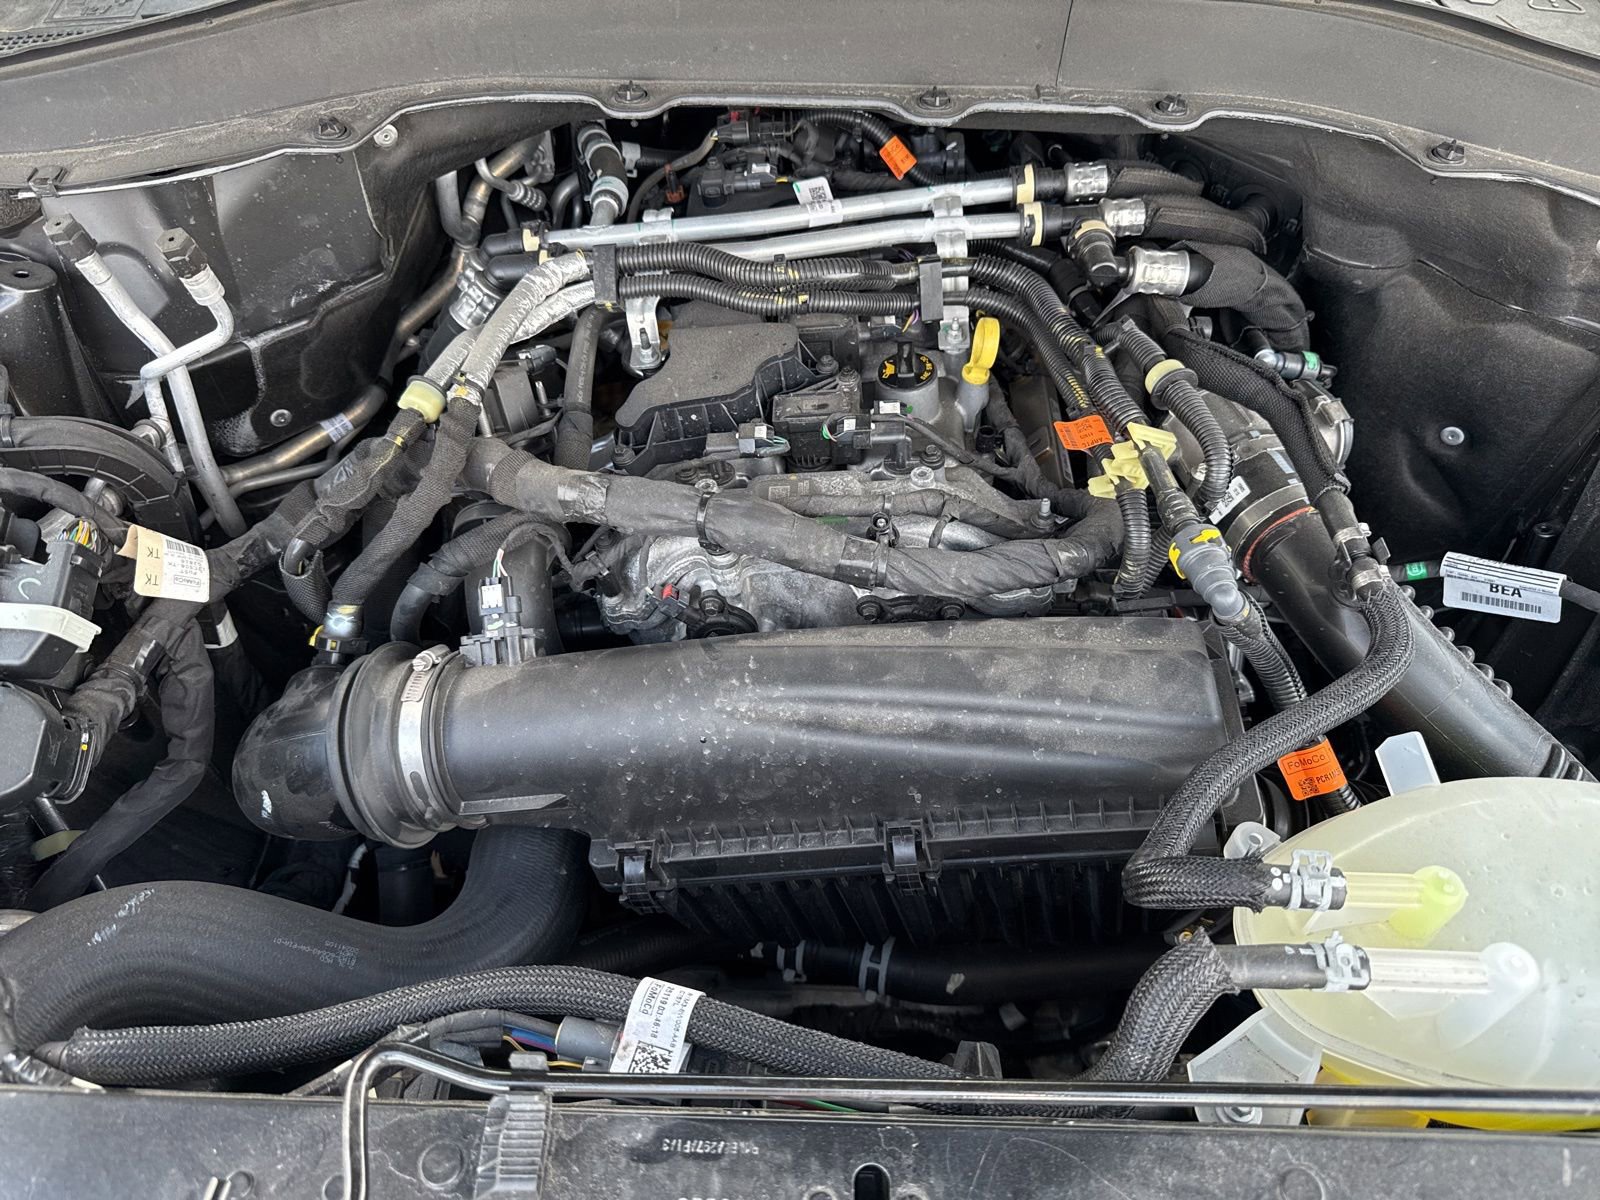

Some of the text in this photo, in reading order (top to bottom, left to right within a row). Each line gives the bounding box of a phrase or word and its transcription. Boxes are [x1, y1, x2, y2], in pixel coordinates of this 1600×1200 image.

[147, 546, 160, 559] TK
[145, 573, 159, 586] TK
[1489, 583, 1522, 598] BEA
[1287, 754, 1325, 770] FoMoCo
[641, 983, 662, 1015] FoMoCo
